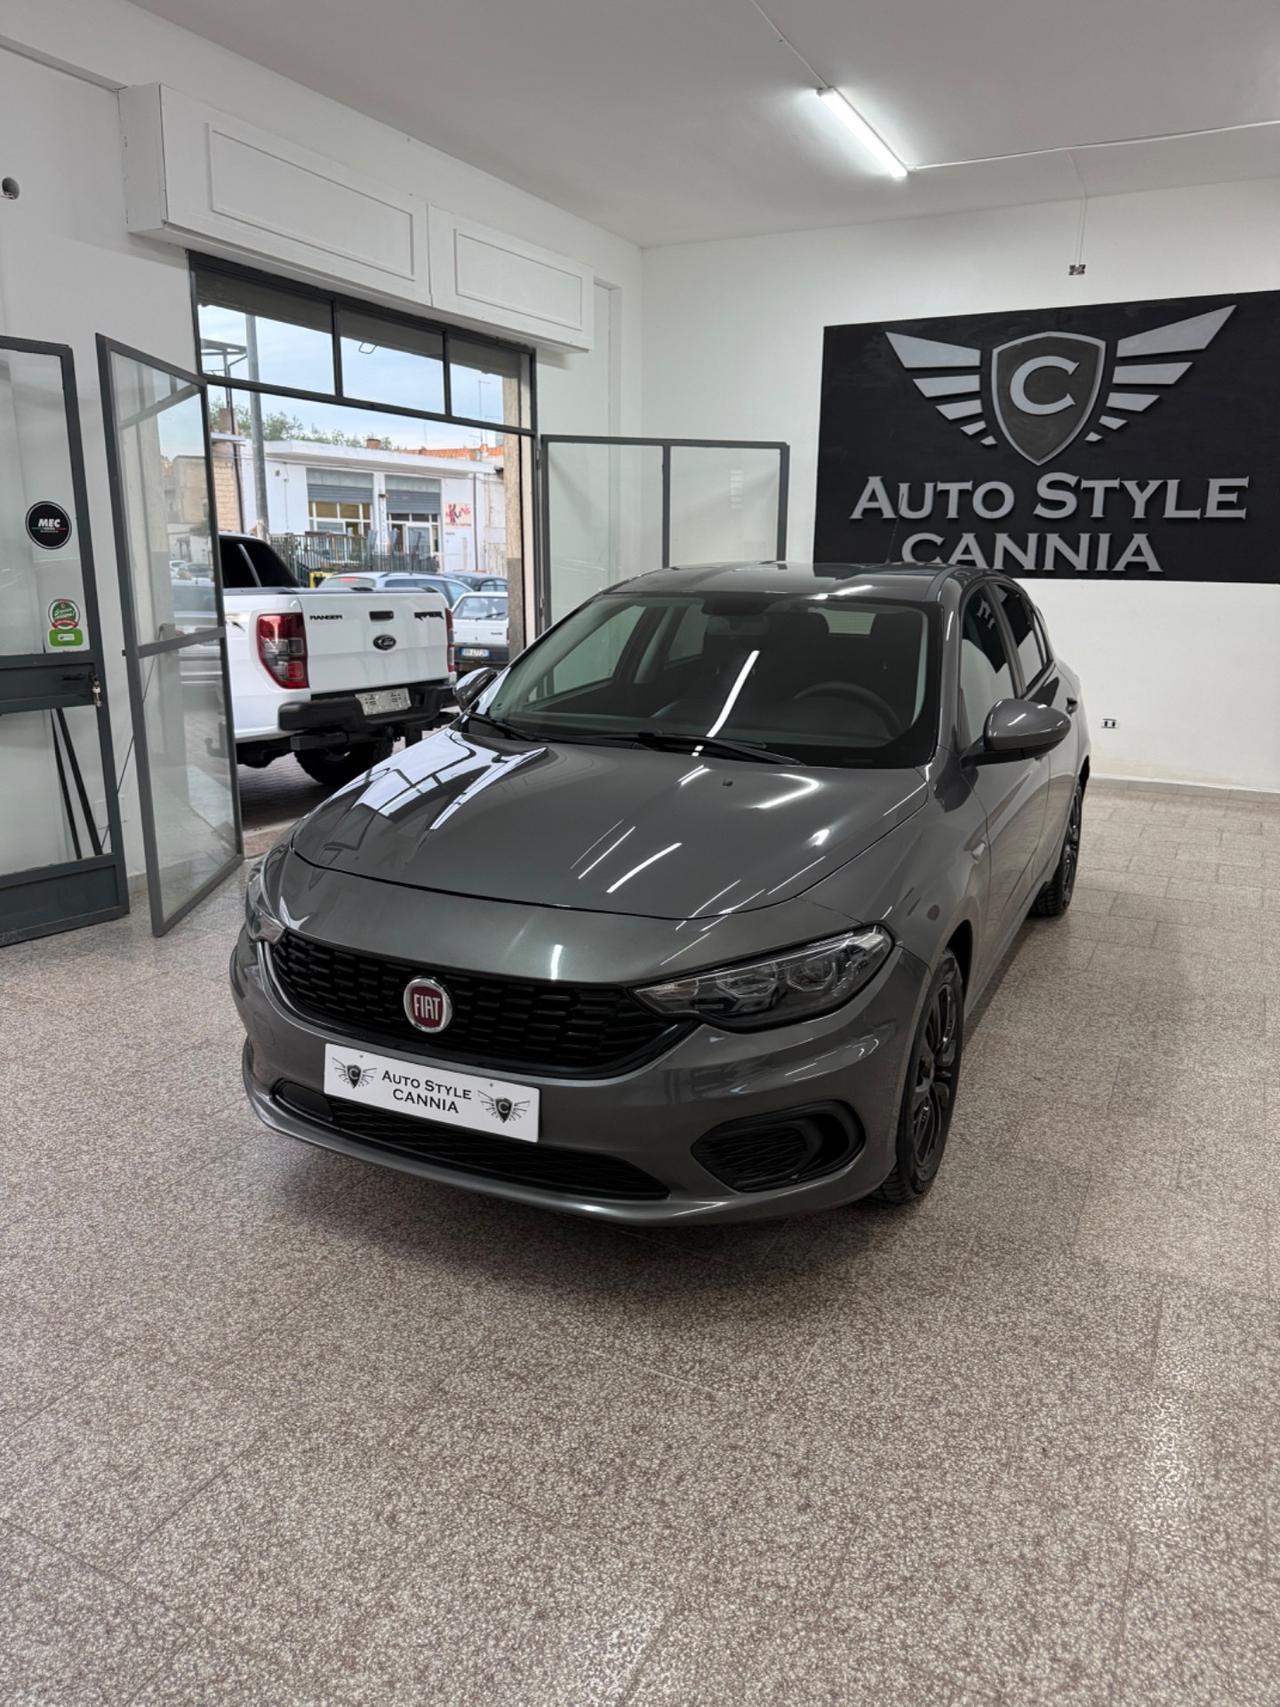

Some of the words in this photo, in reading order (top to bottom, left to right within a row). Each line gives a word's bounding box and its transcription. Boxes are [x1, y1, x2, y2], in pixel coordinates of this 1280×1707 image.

[1009, 355, 1080, 415] C
[37, 518, 61, 528] MEC
[901, 532, 1164, 573] CANNIA
[413, 993, 441, 1020] FIAT
[392, 1088, 460, 1114] CANNIA
